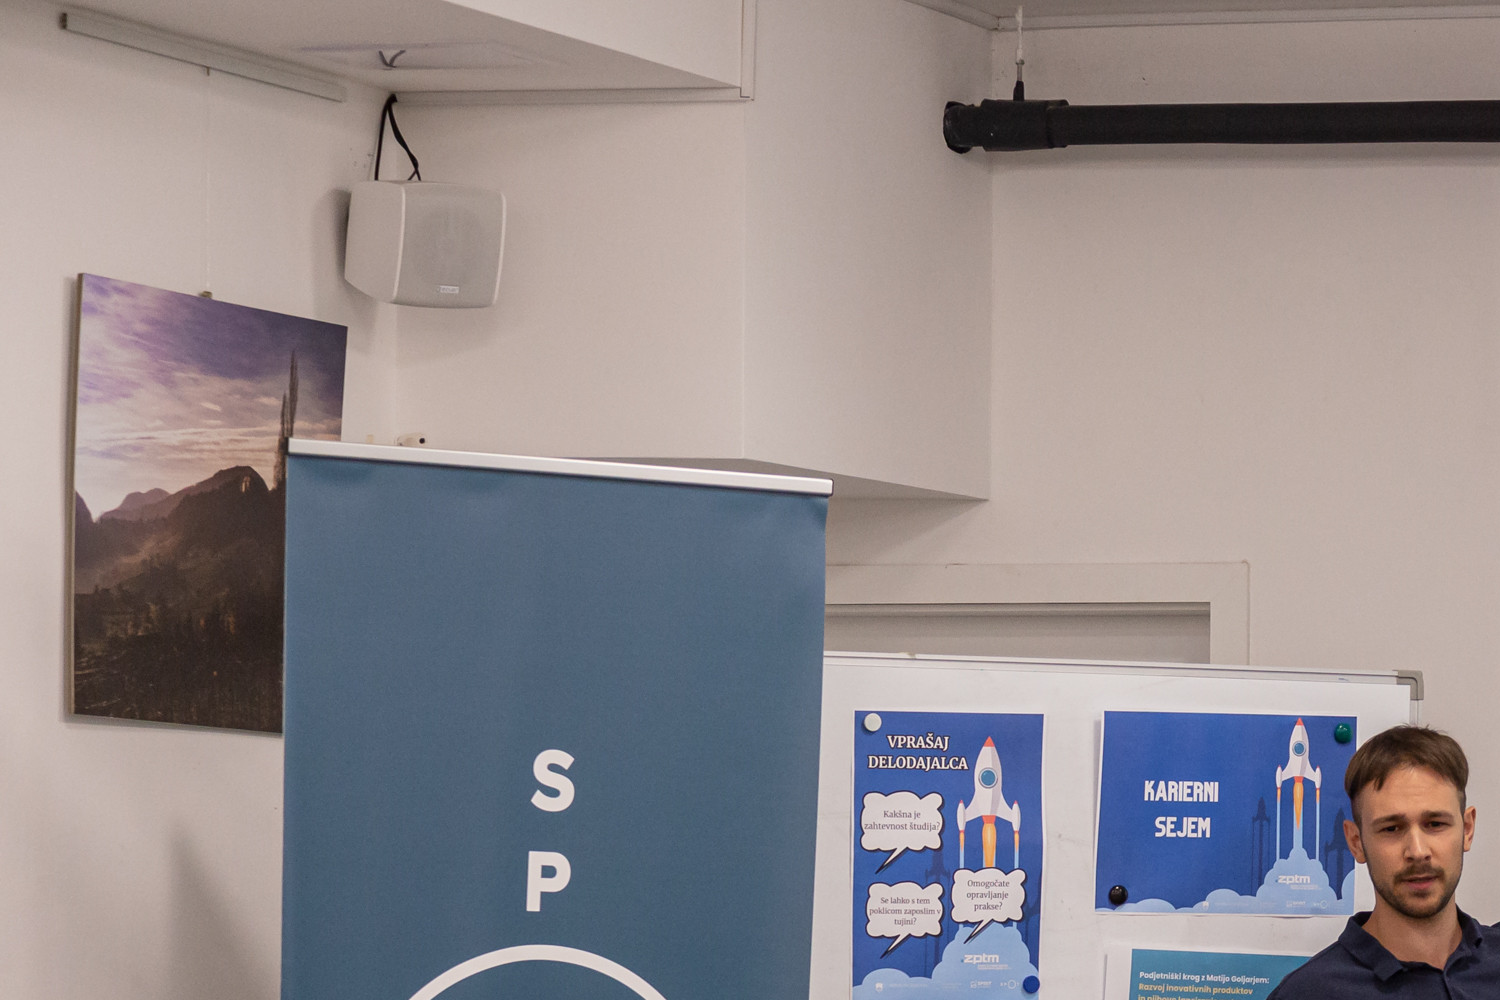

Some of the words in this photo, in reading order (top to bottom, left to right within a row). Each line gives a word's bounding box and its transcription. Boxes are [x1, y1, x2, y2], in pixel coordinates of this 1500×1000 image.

[887, 732, 950, 751] VPRAŠAJ
[868, 755, 969, 771] DELODAJALCA
[1144, 780, 1219, 802] KARIERNI
[883, 810, 912, 818] Kakšna
[914, 810, 921, 820] je
[864, 821, 907, 830] zahtevnost
[909, 821, 940, 832] študija?
[1154, 816, 1211, 838] SEJEM
[967, 879, 1010, 889] Omogočate
[1278, 874, 1311, 885] zptm
[890, 896, 910, 904] lahko
[966, 890, 1009, 900] opravljanje
[869, 907, 902, 915] poklicom
[903, 907, 935, 916] zaposlim
[974, 902, 1003, 912] prakse?
[894, 917, 917, 926] tujini?
[964, 952, 1000, 965] zptm
[1139, 971, 1182, 980] Podjetniški
[1182, 972, 1200, 983] krog
[1206, 974, 1230, 984] Matijo
[1231, 975, 1270, 985] Goljarjem:
[1138, 983, 1165, 993] Razvoj
[1166, 984, 1212, 993] inovativnih
[1212, 986, 1253, 995] produktov
